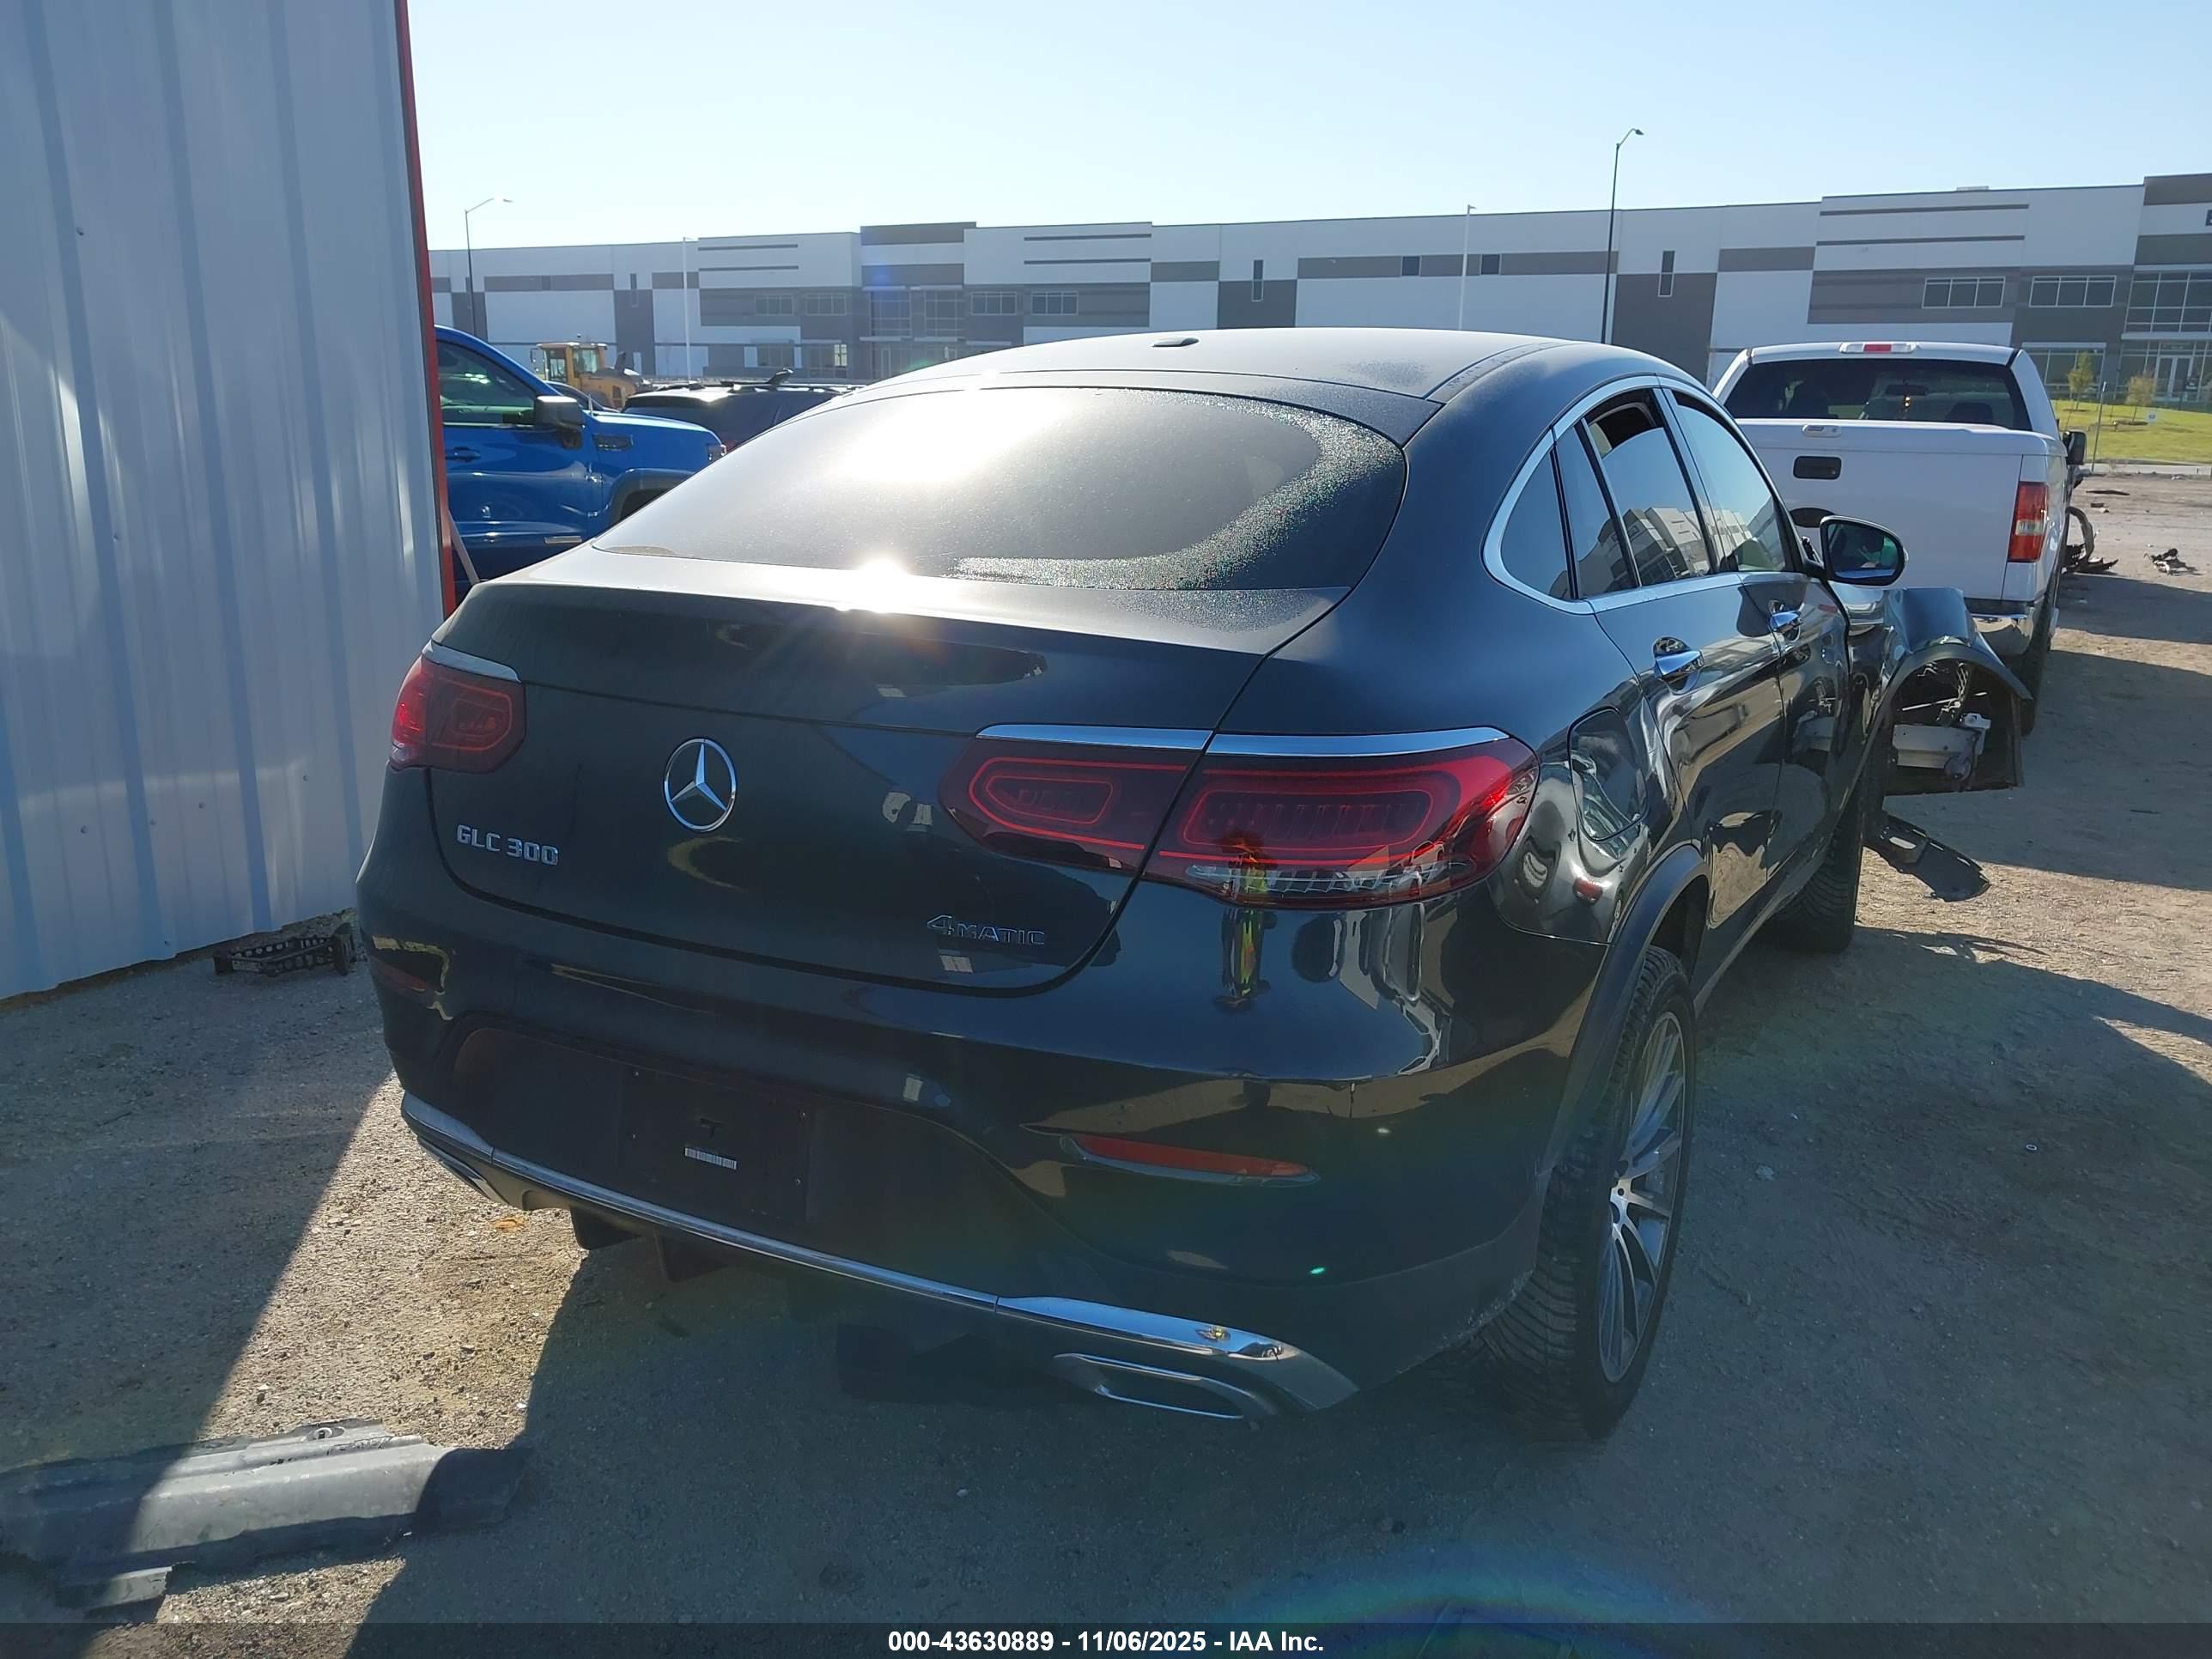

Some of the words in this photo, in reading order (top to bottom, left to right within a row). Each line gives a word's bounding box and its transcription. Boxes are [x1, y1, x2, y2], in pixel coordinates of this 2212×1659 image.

[457, 824, 501, 852] GLC
[507, 838, 559, 866] 300
[927, 915, 1045, 945] 4MATIC
